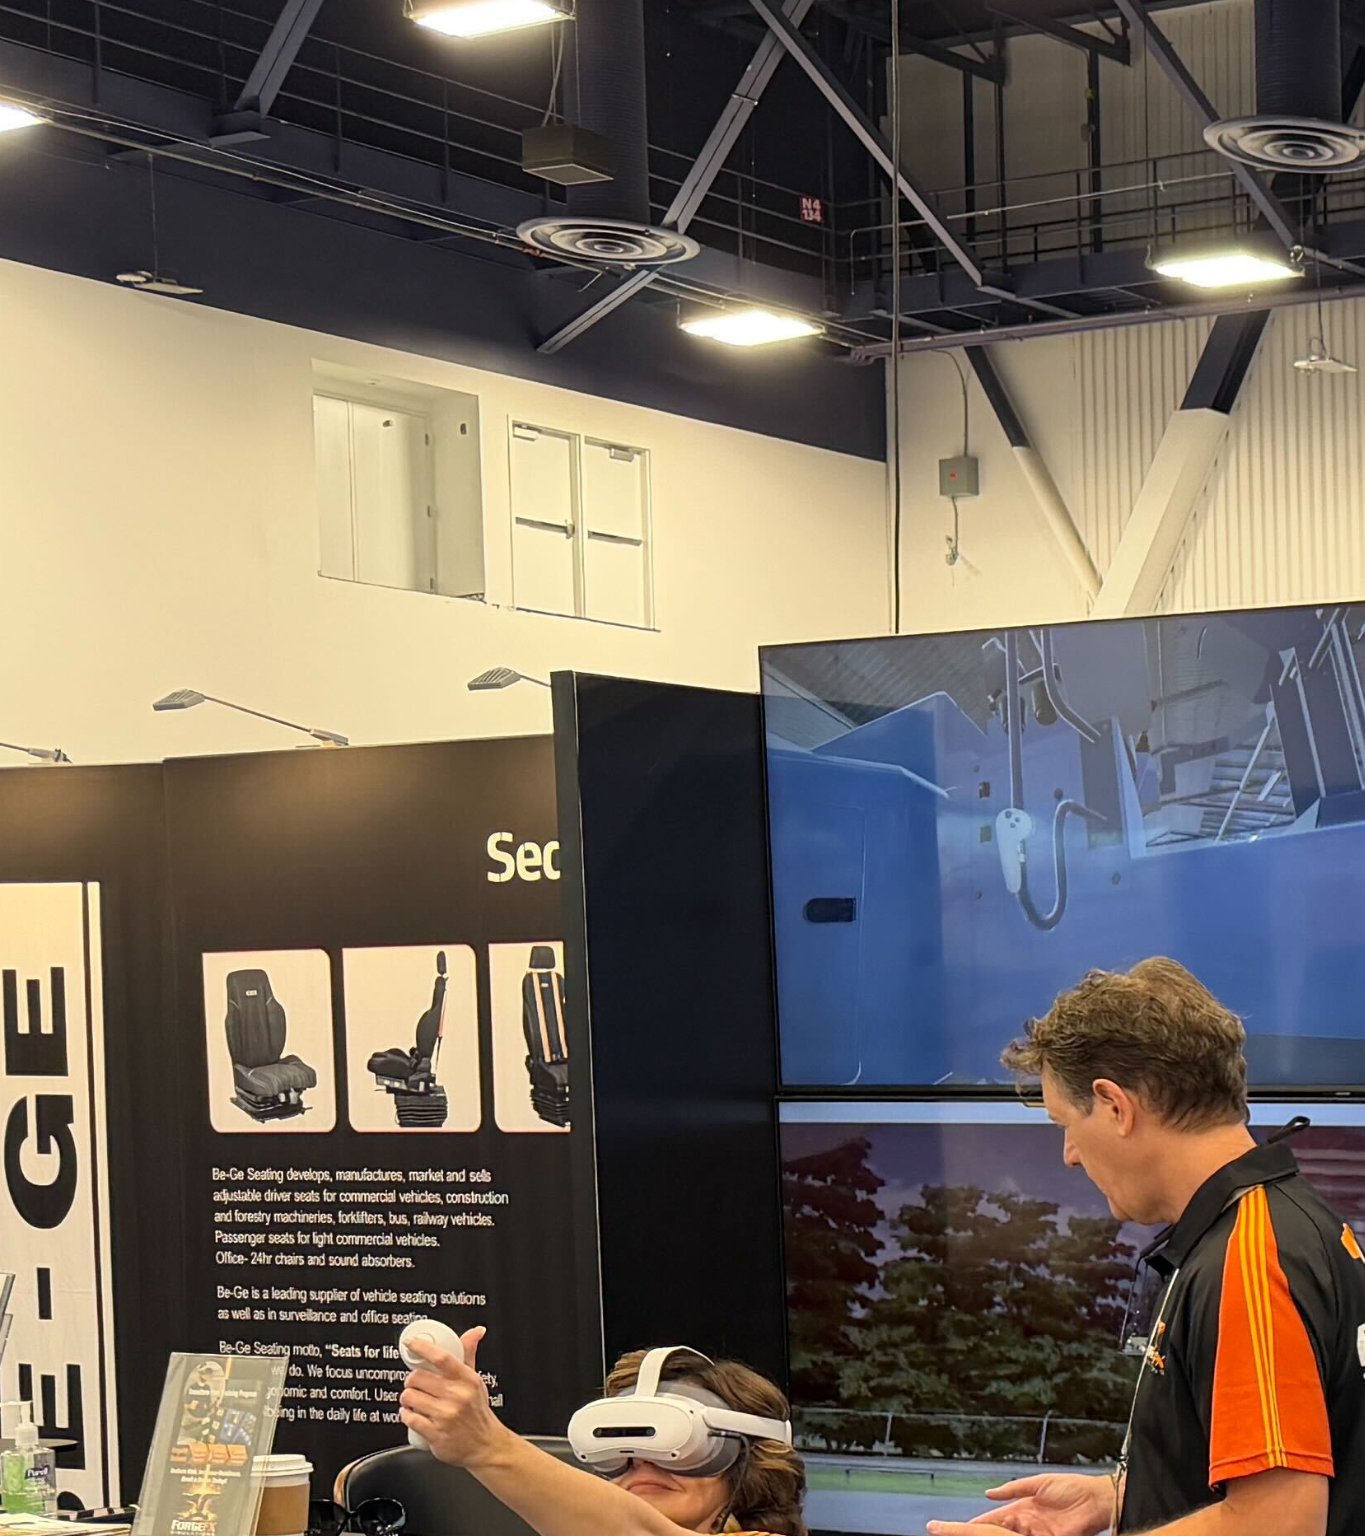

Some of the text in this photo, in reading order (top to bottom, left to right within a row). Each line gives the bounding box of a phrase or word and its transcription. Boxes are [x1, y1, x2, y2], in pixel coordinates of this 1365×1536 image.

[802, 198, 821, 209] N4
[212, 1168, 491, 1184] Be-Ge Seating develops, manufactures, market and sells
[213, 1188, 509, 1205] adjustable driver seats for commercial vehicles, construction
[214, 1210, 232, 1223] and
[234, 1209, 271, 1225] forestry
[274, 1210, 336, 1225] machineries,
[388, 1211, 410, 1226] bus,
[413, 1211, 449, 1228] railway
[450, 1211, 495, 1226] vehicles.
[215, 1230, 440, 1248] Passenger seats for light commercial vehicles.
[215, 1251, 415, 1268] Office- 24hr chairs and sound absorbers.
[217, 1285, 486, 1307] Be-Ge is a leading supplier of vehicle seating solutions
[218, 1309, 229, 1320] as
[231, 1307, 251, 1320] well
[253, 1309, 265, 1320] as
[267, 1308, 277, 1321] in
[340, 1309, 358, 1323] and
[360, 1310, 389, 1323] office
[219, 1340, 251, 1354] Be-Ge
[253, 1341, 290, 1357] Seating
[293, 1343, 322, 1358] motto,
[364, 1345, 380, 1358] for
[289, 1365, 304, 1377] do.
[307, 1364, 323, 1378] We
[326, 1365, 353, 1378] focus
[355, 1368, 410, 1383] uncompro
[309, 1386, 327, 1399] and
[330, 1388, 371, 1401] comfort.
[374, 1388, 399, 1401] User
[297, 1405, 306, 1418] in
[309, 1406, 324, 1419] the
[327, 1406, 350, 1424] daily
[353, 1408, 367, 1422] life
[369, 1409, 380, 1422] at
